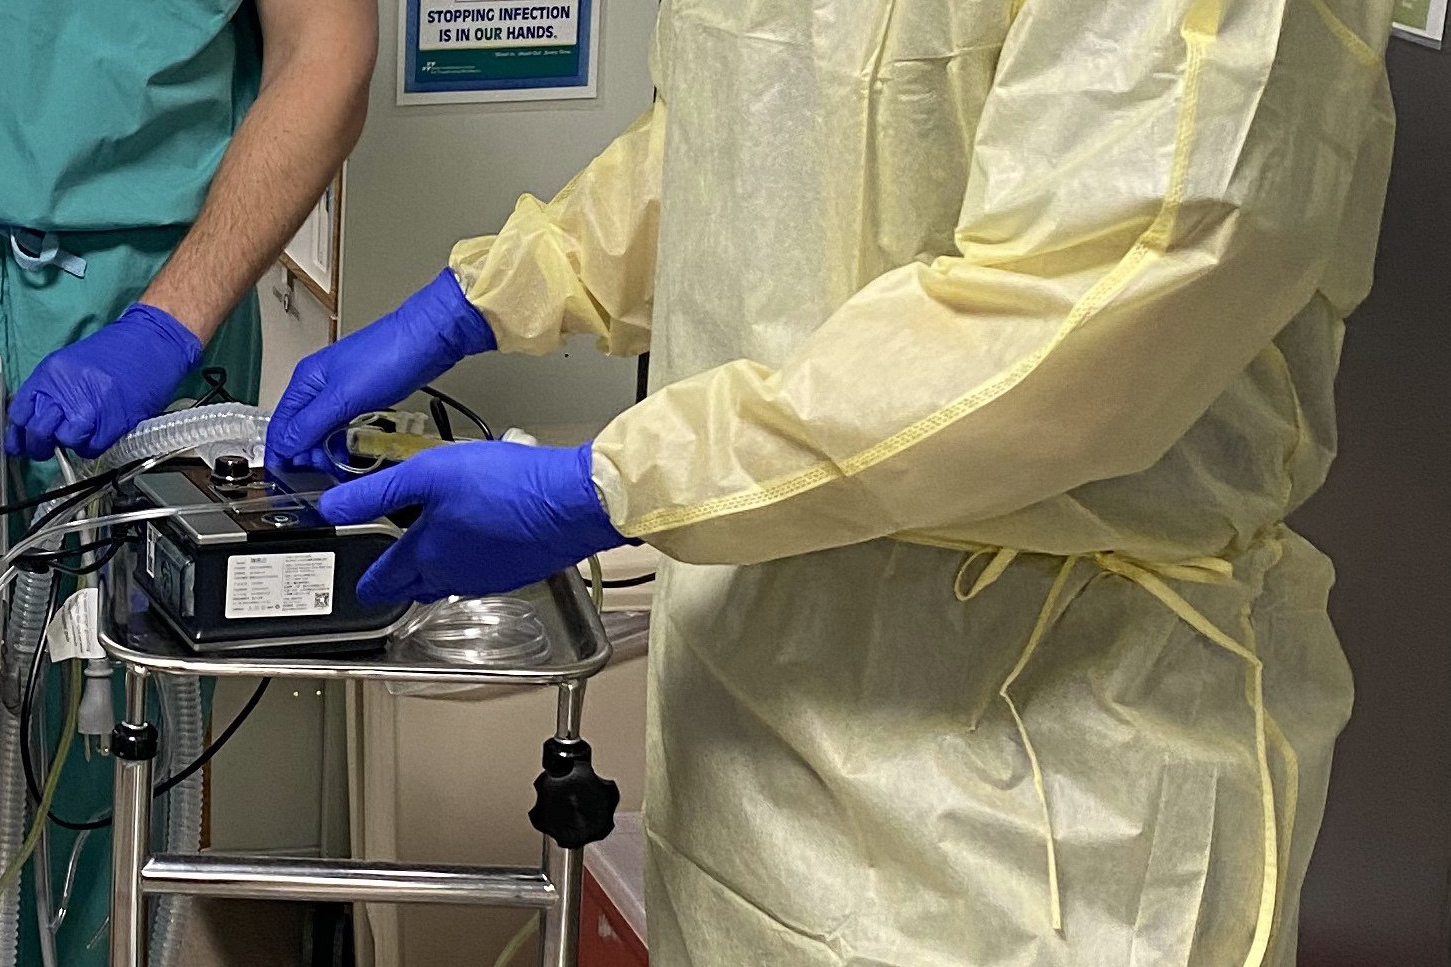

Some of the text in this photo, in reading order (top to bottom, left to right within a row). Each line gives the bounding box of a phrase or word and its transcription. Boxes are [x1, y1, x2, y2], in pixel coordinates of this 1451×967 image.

[427, 5, 571, 24] STOPPING INFECTION
[439, 25, 558, 43] IS IN OUR HANDS.
